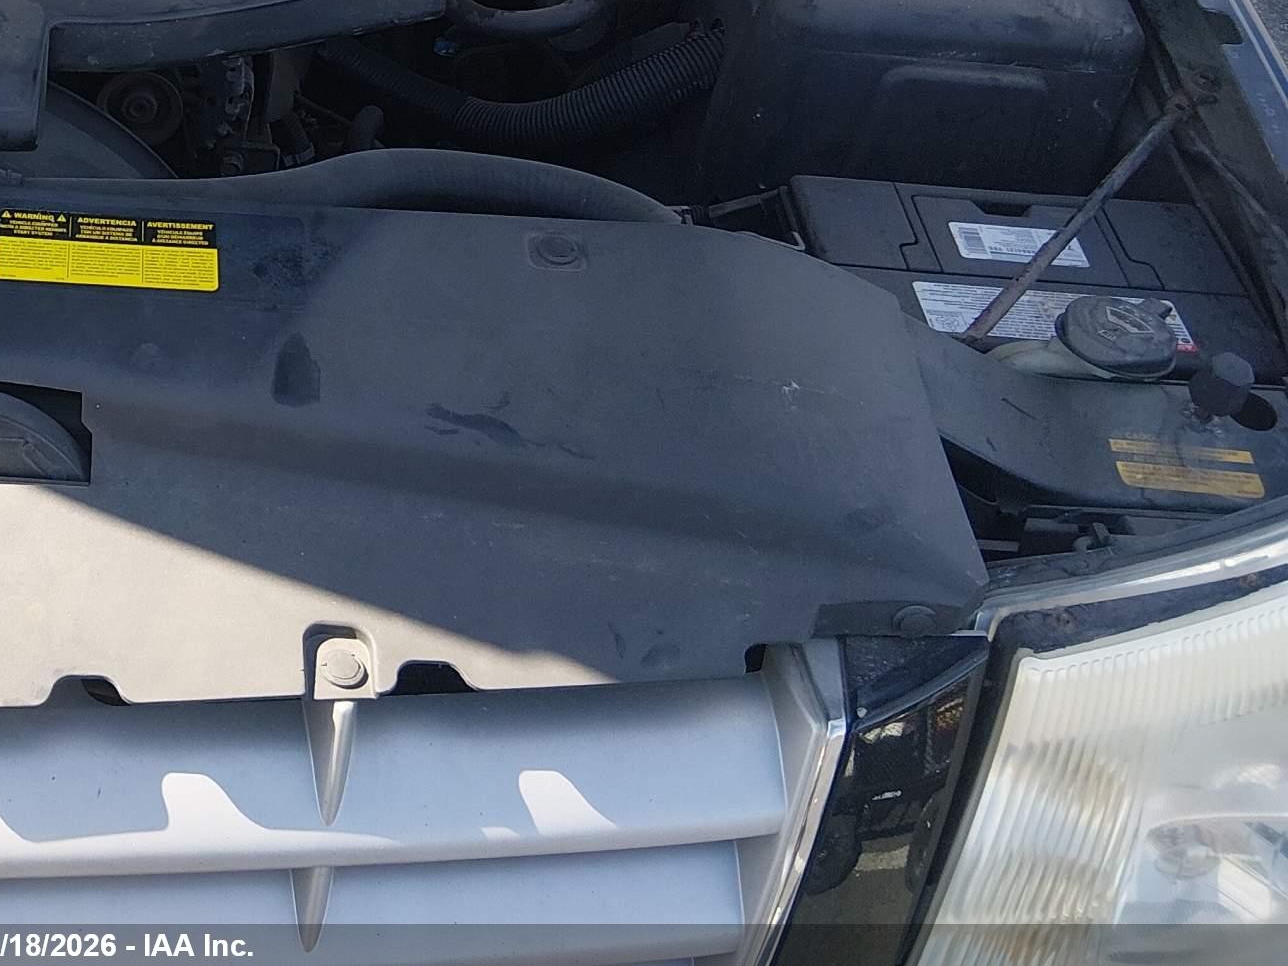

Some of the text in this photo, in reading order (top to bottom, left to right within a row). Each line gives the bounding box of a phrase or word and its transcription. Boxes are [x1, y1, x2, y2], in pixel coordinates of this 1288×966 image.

[14, 212, 55, 221] WARNING
[77, 217, 137, 226] ADVERTENCIA
[146, 221, 214, 230] AVERTISSEMENT
